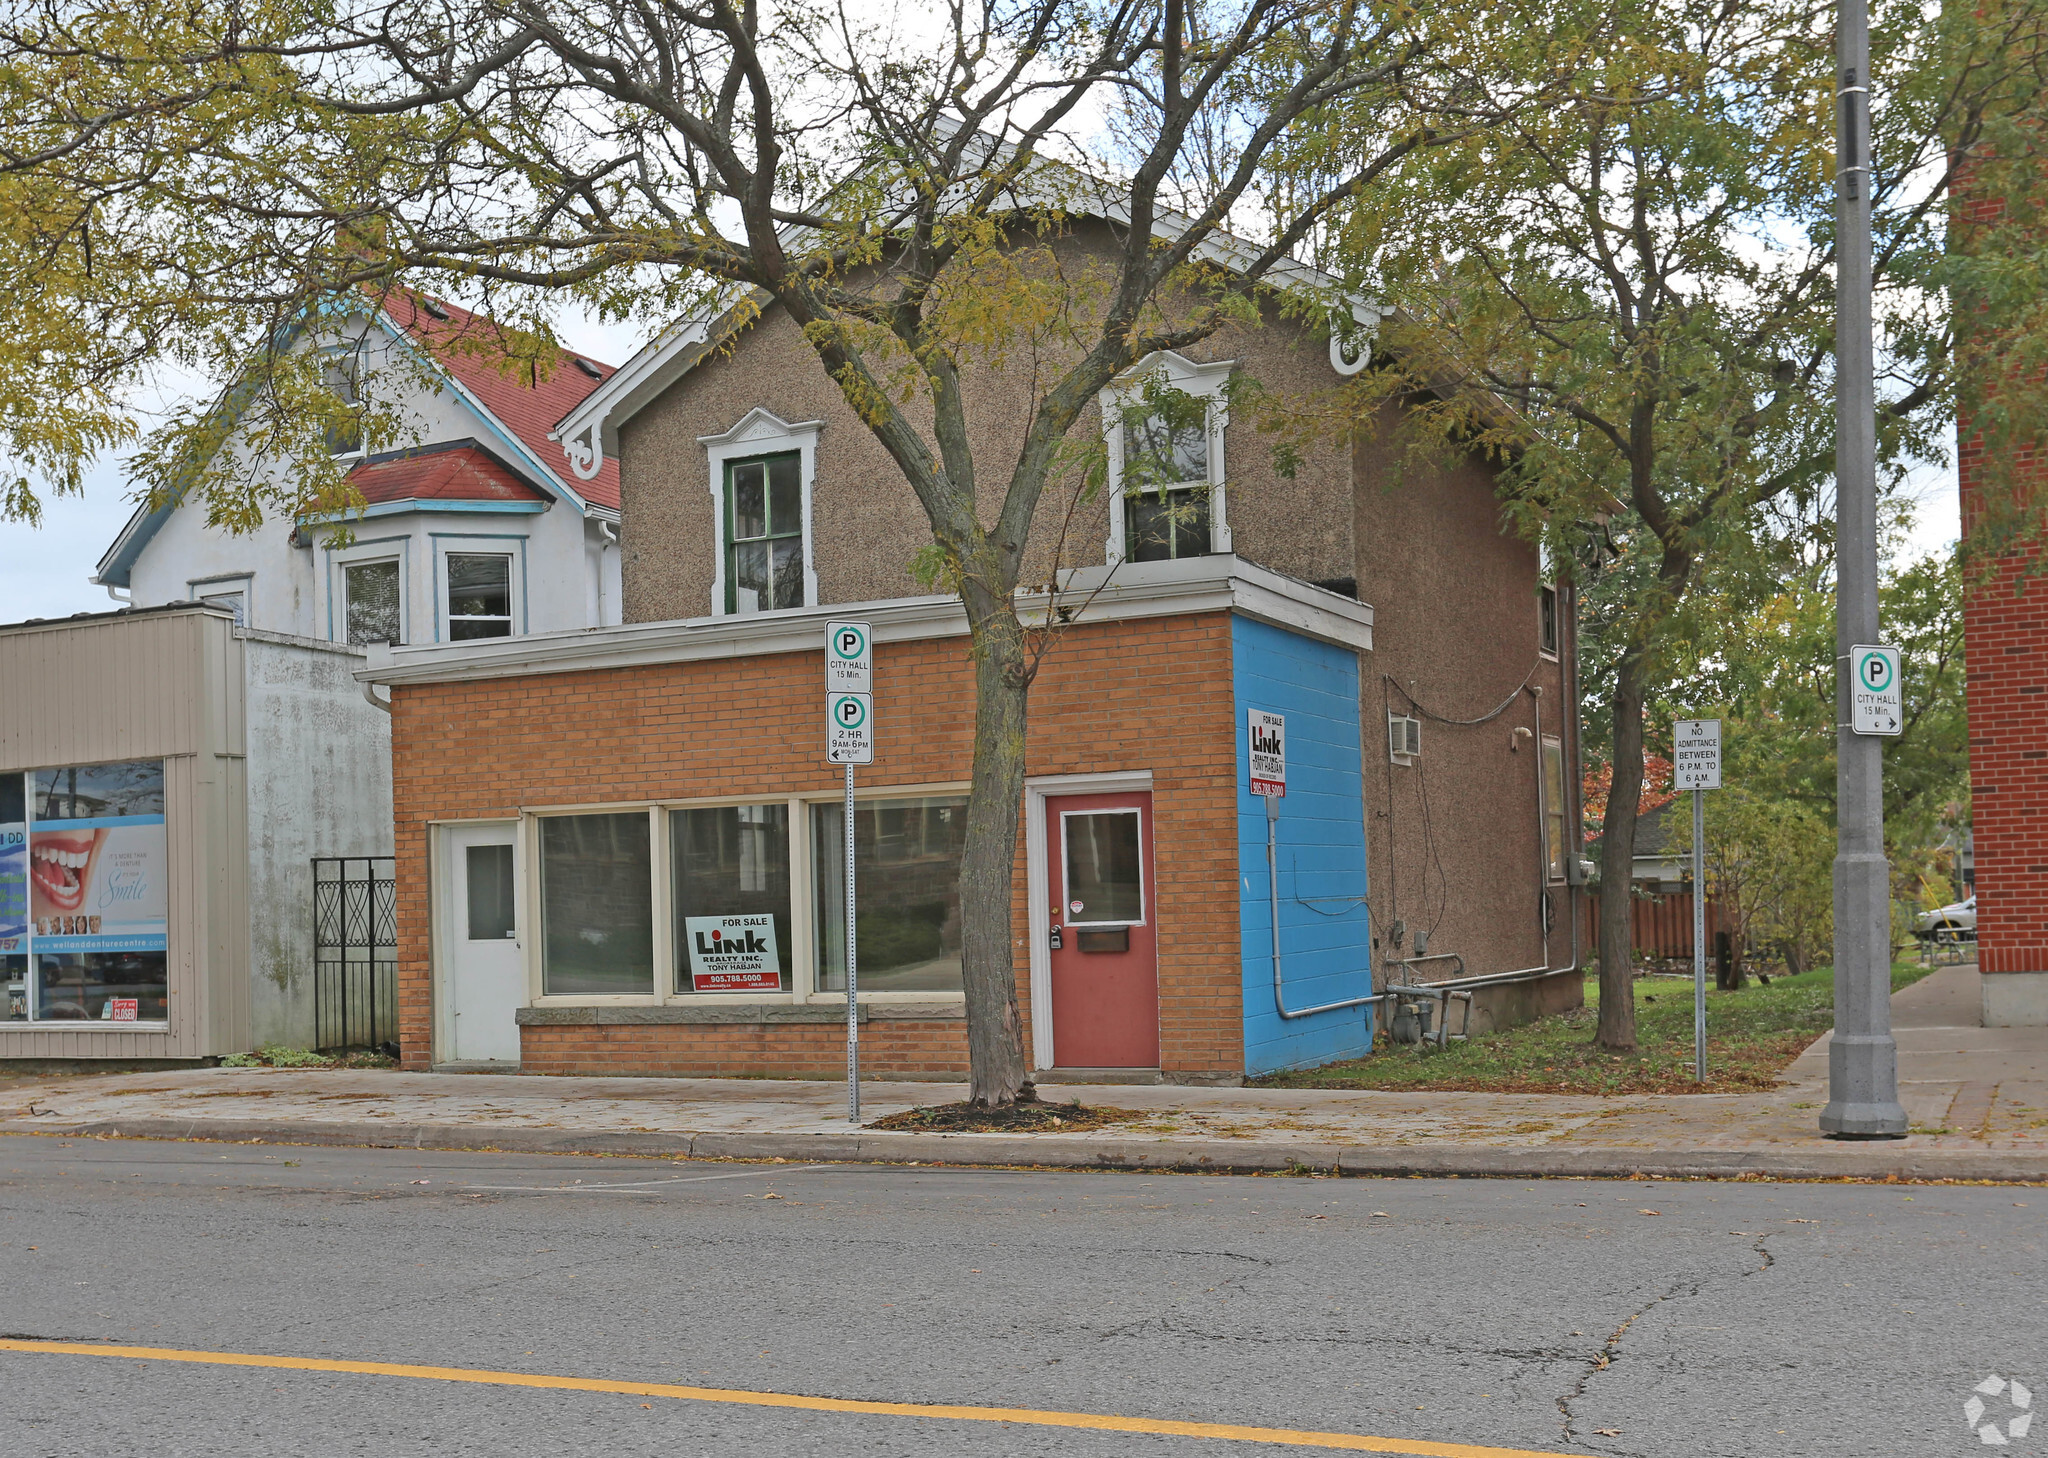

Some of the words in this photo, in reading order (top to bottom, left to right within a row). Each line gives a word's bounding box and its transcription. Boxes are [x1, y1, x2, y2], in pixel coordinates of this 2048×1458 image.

[843, 633, 857, 651] P
[830, 660, 847, 669] CITY
[849, 661, 868, 670] HALL
[836, 670, 845, 679] 15
[846, 670, 862, 679] Min.
[1870, 661, 1884, 682] P
[1857, 694, 1875, 704] CITY
[1877, 694, 1897, 705] HALL
[844, 703, 857, 721] P
[1864, 706, 1873, 715] 15
[1875, 706, 1891, 716] Min.
[1262, 715, 1271, 725] FOR
[1271, 717, 1283, 727] SALE
[838, 730, 845, 739] 2
[848, 730, 862, 739] HR
[1691, 728, 1703, 736] NO
[1678, 738, 1717, 748] ADMITTANCE
[1254, 754, 1269, 763] REALTY
[1679, 750, 1716, 760] BETWEEN
[1252, 760, 1264, 772] TONY
[1679, 763, 1685, 771] 6
[1687, 762, 1703, 771] P.M.
[1706, 761, 1716, 770] TO
[1685, 774, 1691, 782] 6
[1694, 773, 1710, 782] A.M.
[118, 852, 132, 860] MORE
[98, 868, 147, 909] Smile
[722, 918, 741, 927] FOR
[743, 917, 768, 926] SALE
[703, 955, 738, 963] REALTY
[708, 964, 729, 972] TONY
[730, 963, 762, 971] HABJAN
[710, 974, 762, 983] 905.788.5000
[114, 1008, 135, 1020] CLOSED
